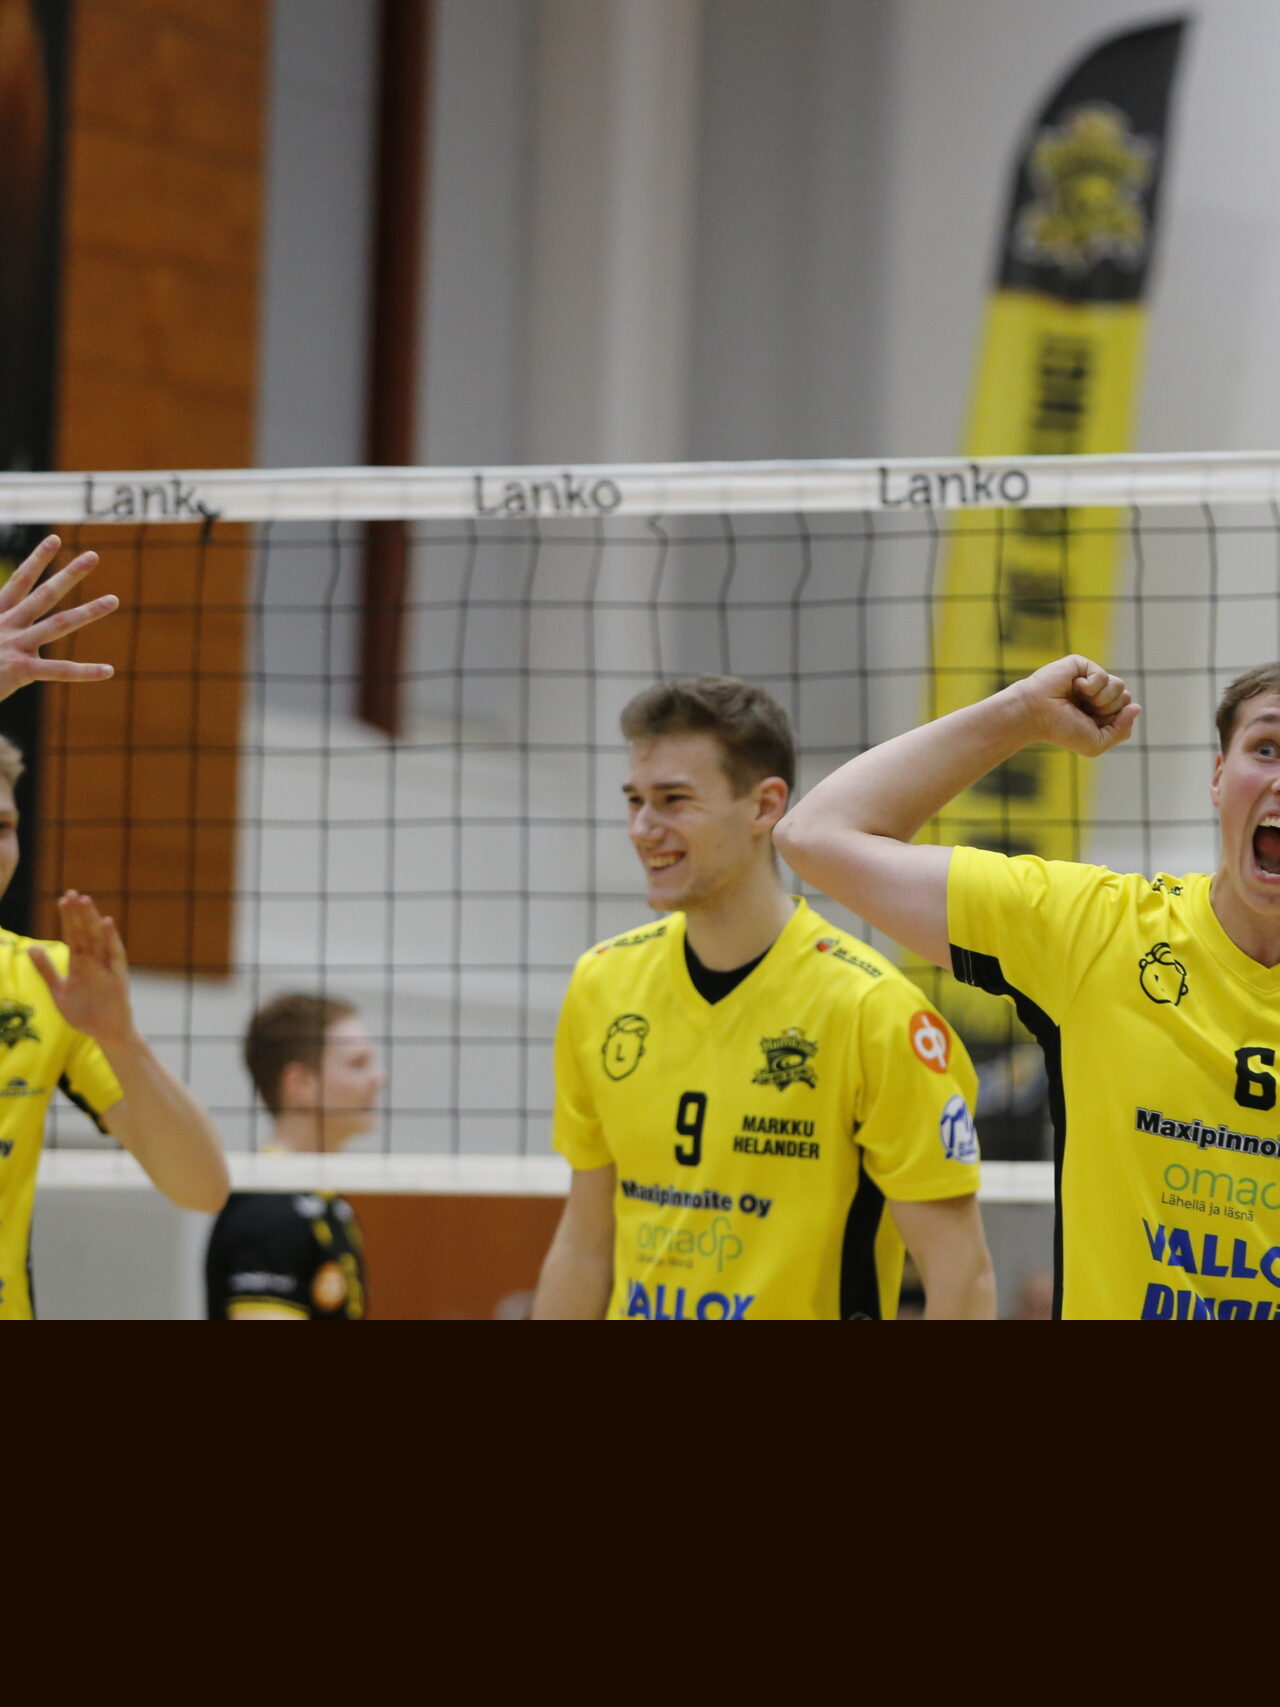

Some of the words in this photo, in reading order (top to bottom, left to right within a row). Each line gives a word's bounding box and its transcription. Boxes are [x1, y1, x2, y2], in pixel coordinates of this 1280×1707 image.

[84, 474, 206, 516] Lank
[474, 473, 622, 517] Lanko
[878, 465, 1030, 507] Lanko
[1234, 1047, 1276, 1111] 6
[675, 1091, 708, 1167] 9
[743, 1115, 814, 1137] MARKKU
[733, 1135, 820, 1160] HELANDER
[739, 1193, 772, 1218] Oy
[1161, 1192, 1206, 1213] Lähellä
[1208, 1206, 1220, 1220] ja
[1224, 1207, 1254, 1222] läsnä
[628, 1278, 755, 1320] ALLOX
